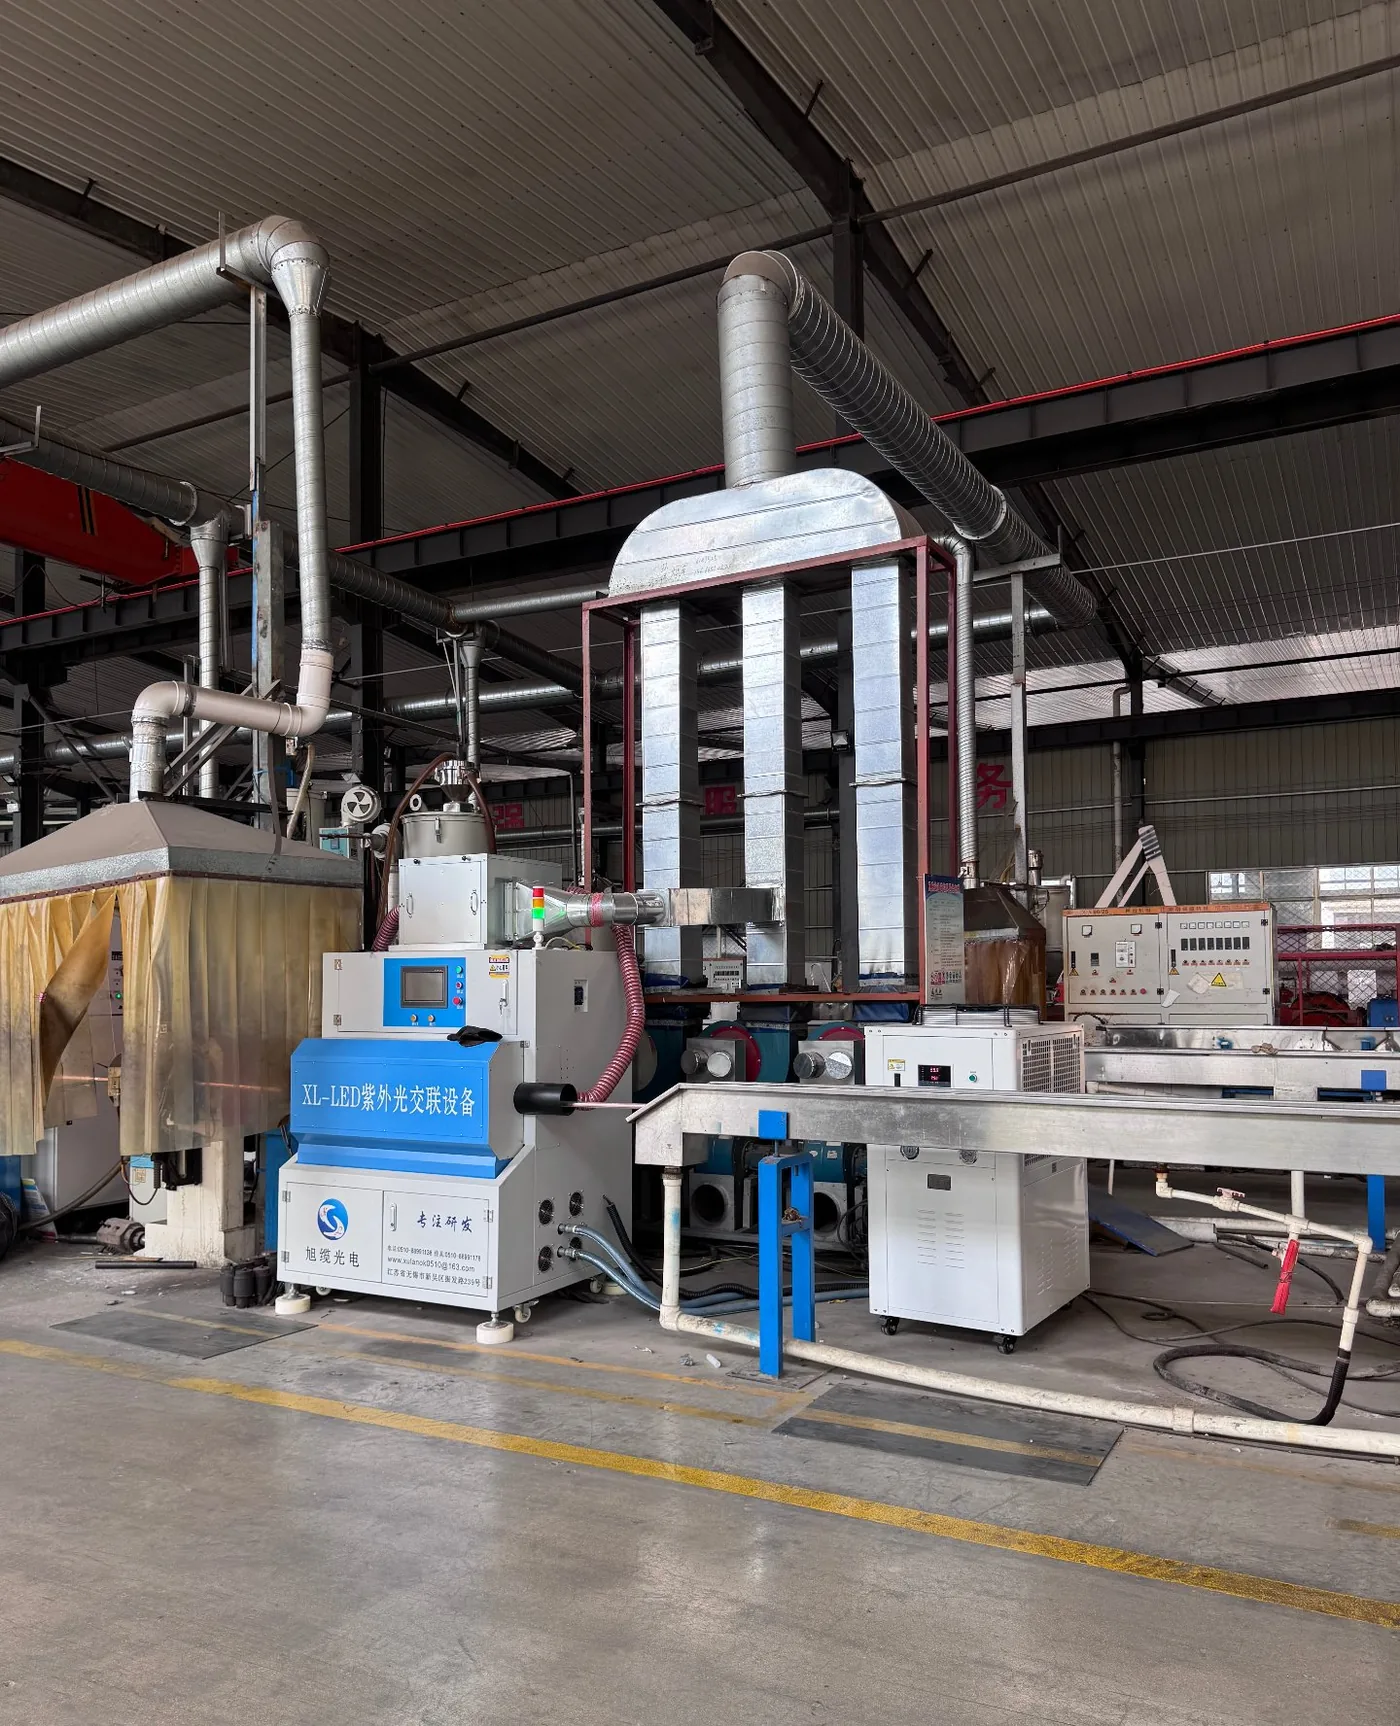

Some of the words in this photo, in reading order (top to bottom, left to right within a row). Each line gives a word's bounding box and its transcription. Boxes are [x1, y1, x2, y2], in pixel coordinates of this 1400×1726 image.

[302, 1083, 475, 1117] XL-LED紫外光交联设备
[417, 1210, 473, 1233] 专注研发
[305, 1246, 360, 1268] 旭缆光电
